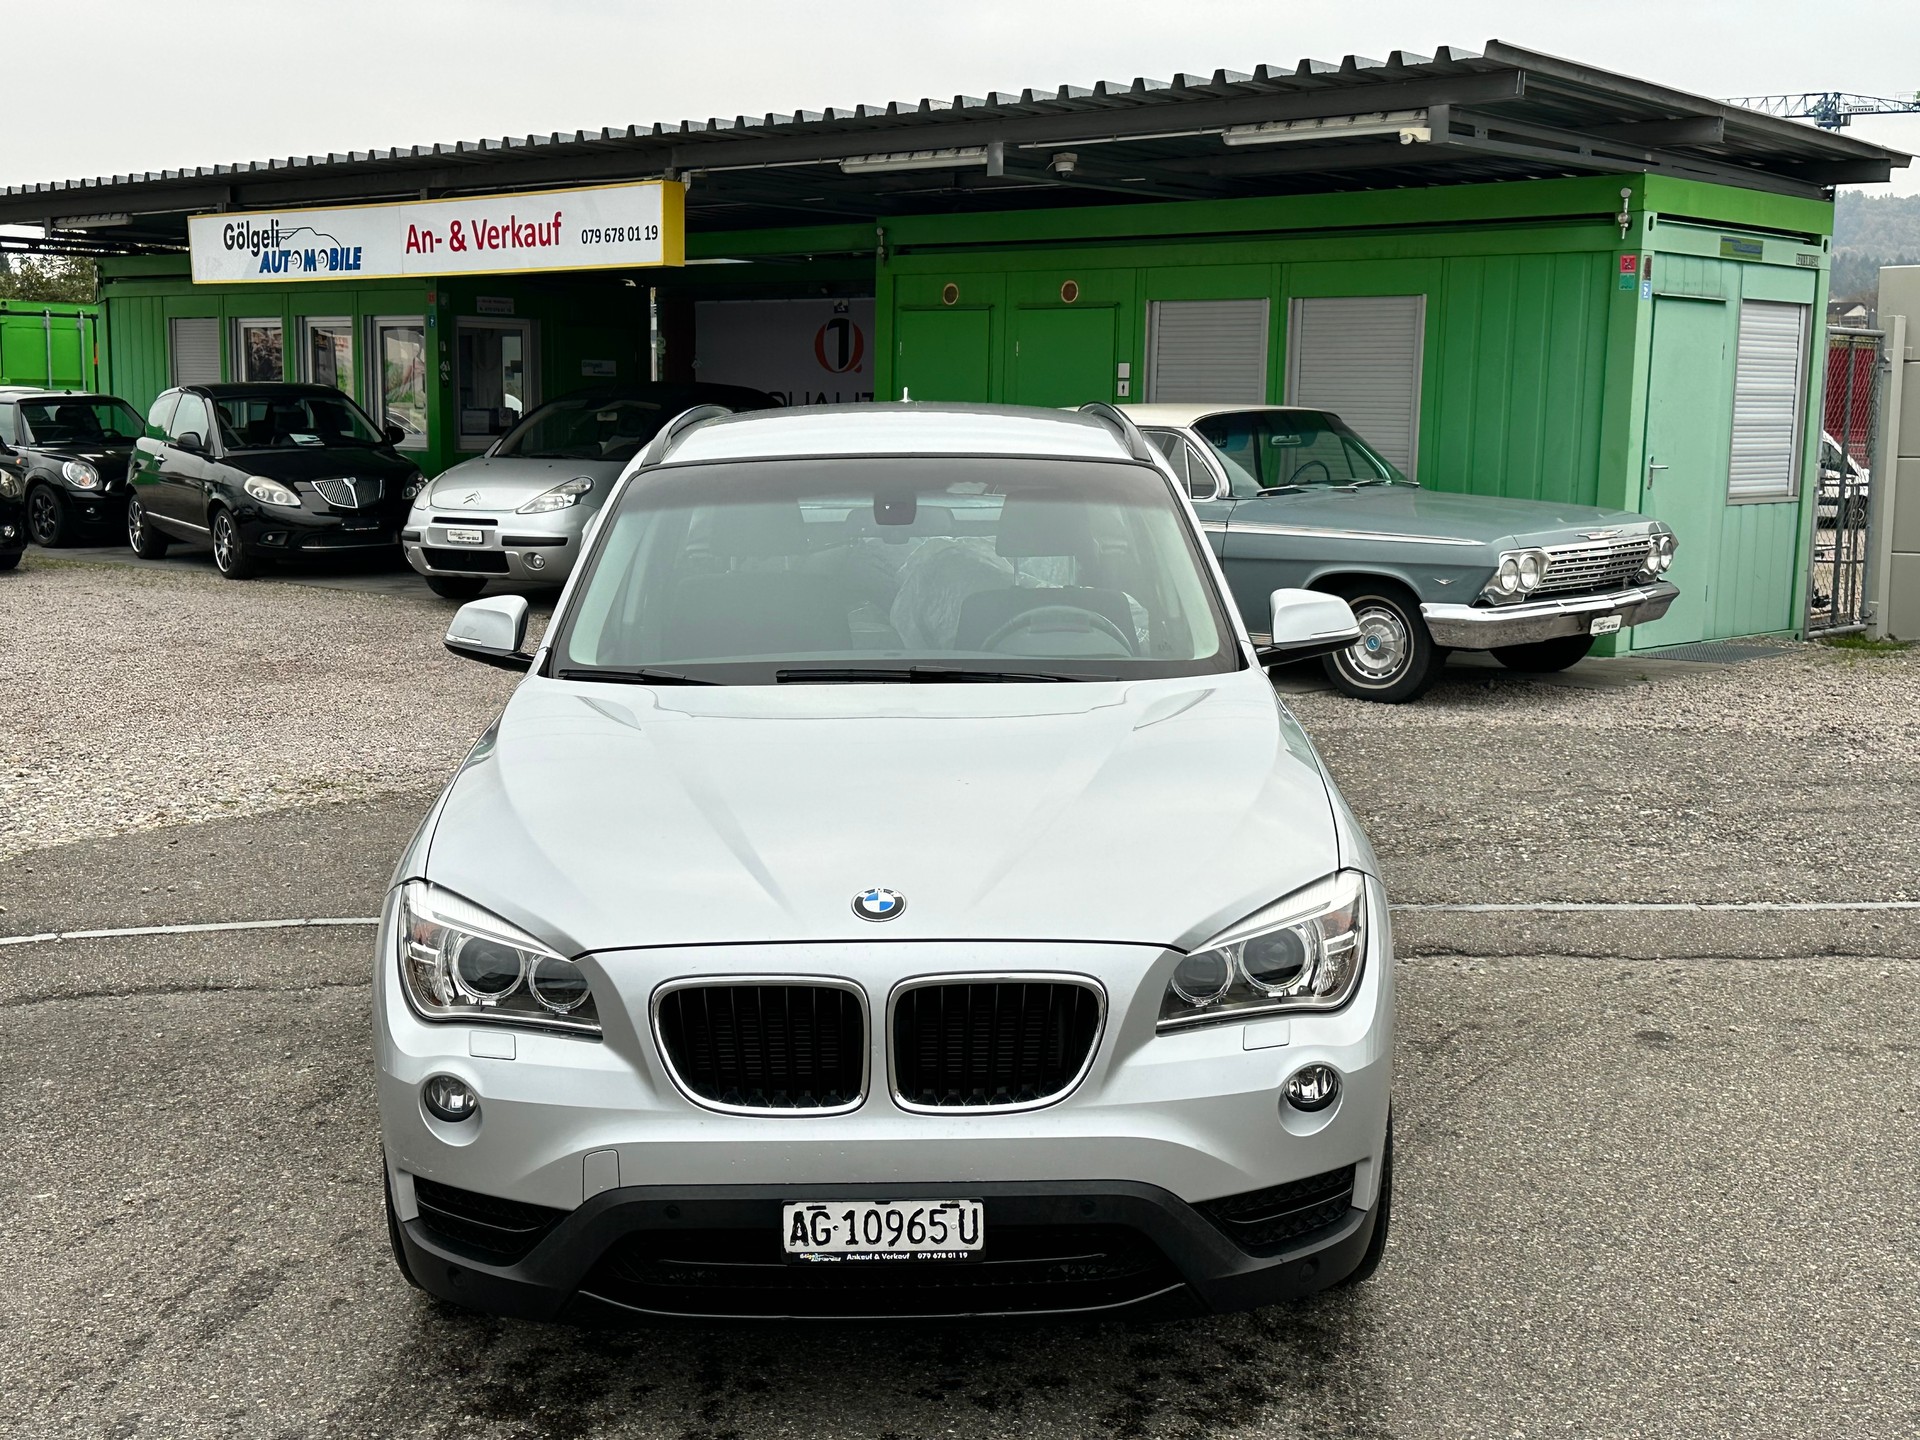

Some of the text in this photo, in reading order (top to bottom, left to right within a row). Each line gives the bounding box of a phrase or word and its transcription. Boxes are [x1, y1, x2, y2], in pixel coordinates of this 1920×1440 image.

[223, 218, 280, 258] Gölgeli
[405, 211, 562, 254] An- & Verkauf
[581, 224, 659, 245] 079 678 01 19
[846, 1252, 873, 1261] Ankauf
[881, 1252, 910, 1260] Verkauf
[917, 1252, 931, 1260] 079
[959, 1251, 968, 1259] 19
